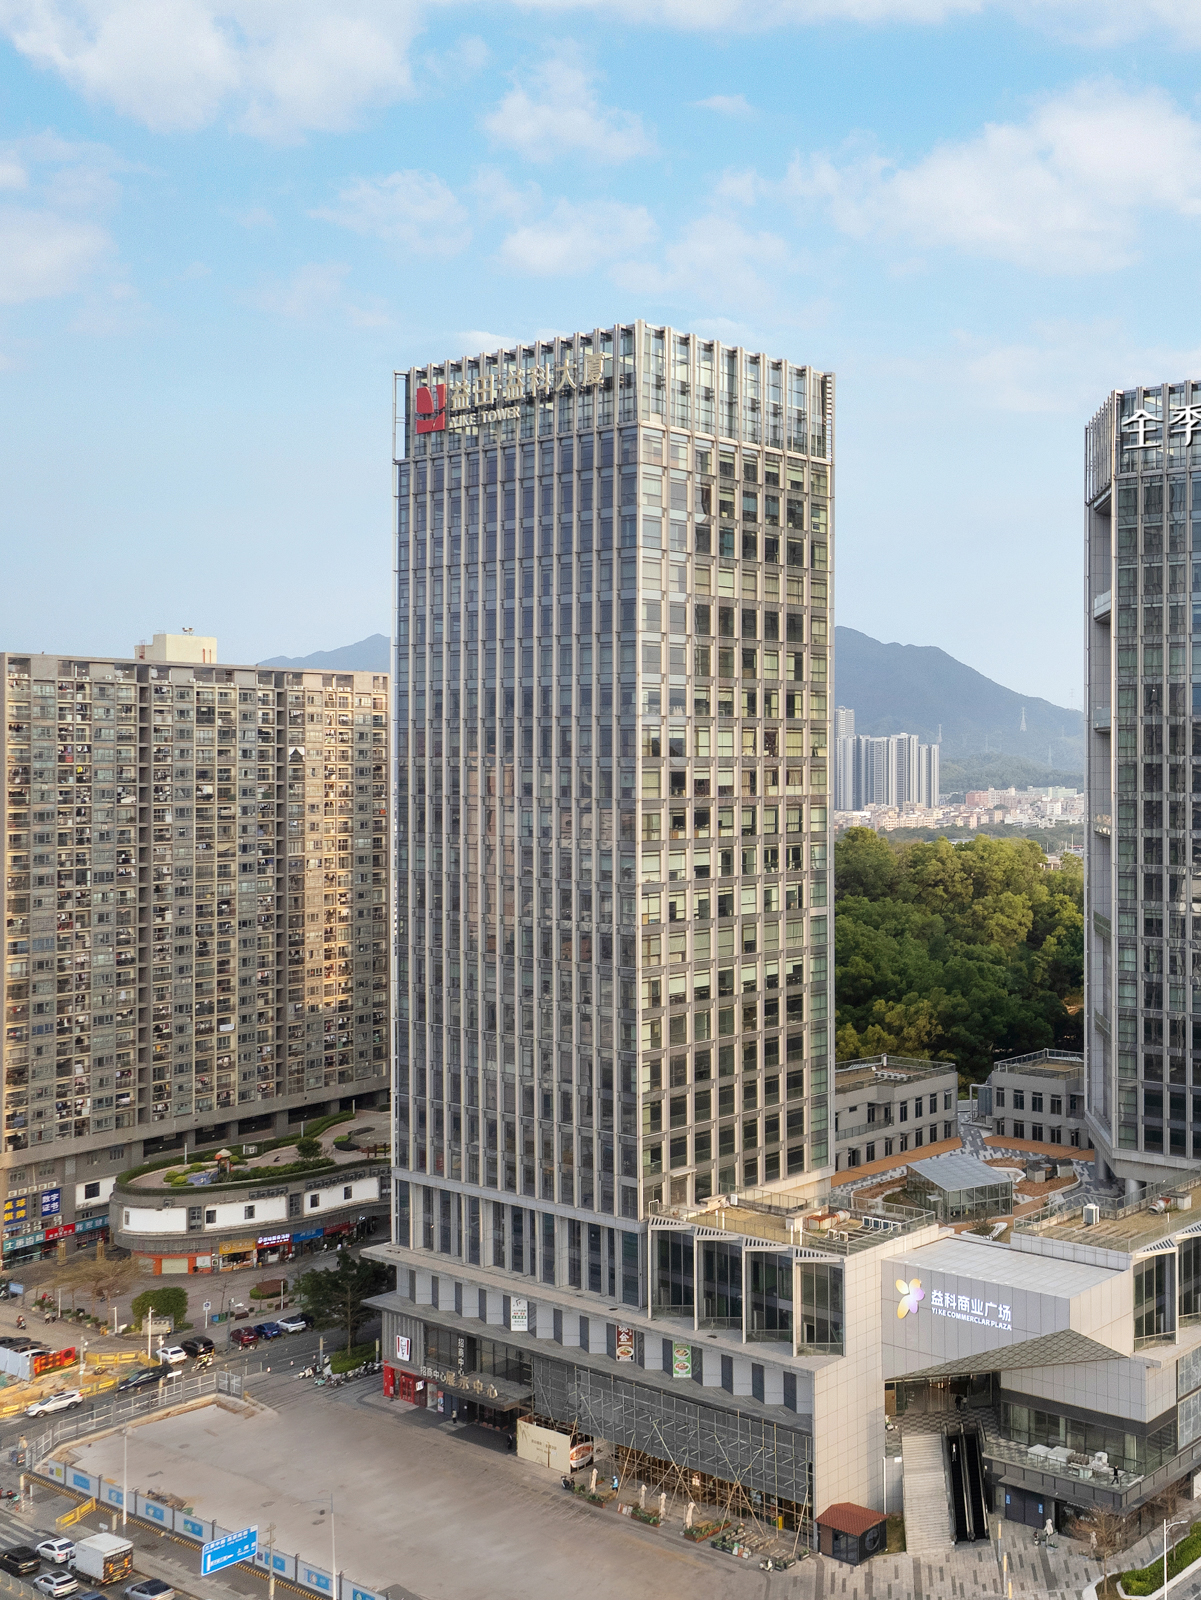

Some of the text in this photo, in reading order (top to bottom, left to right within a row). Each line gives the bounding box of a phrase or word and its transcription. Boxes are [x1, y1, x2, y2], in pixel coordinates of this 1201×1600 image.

[480, 406, 520, 423] TOWER
[931, 1289, 1012, 1322] 益科商业广场
[420, 1366, 446, 1382] 招商中心
[446, 1370, 498, 1399] 展示中心
